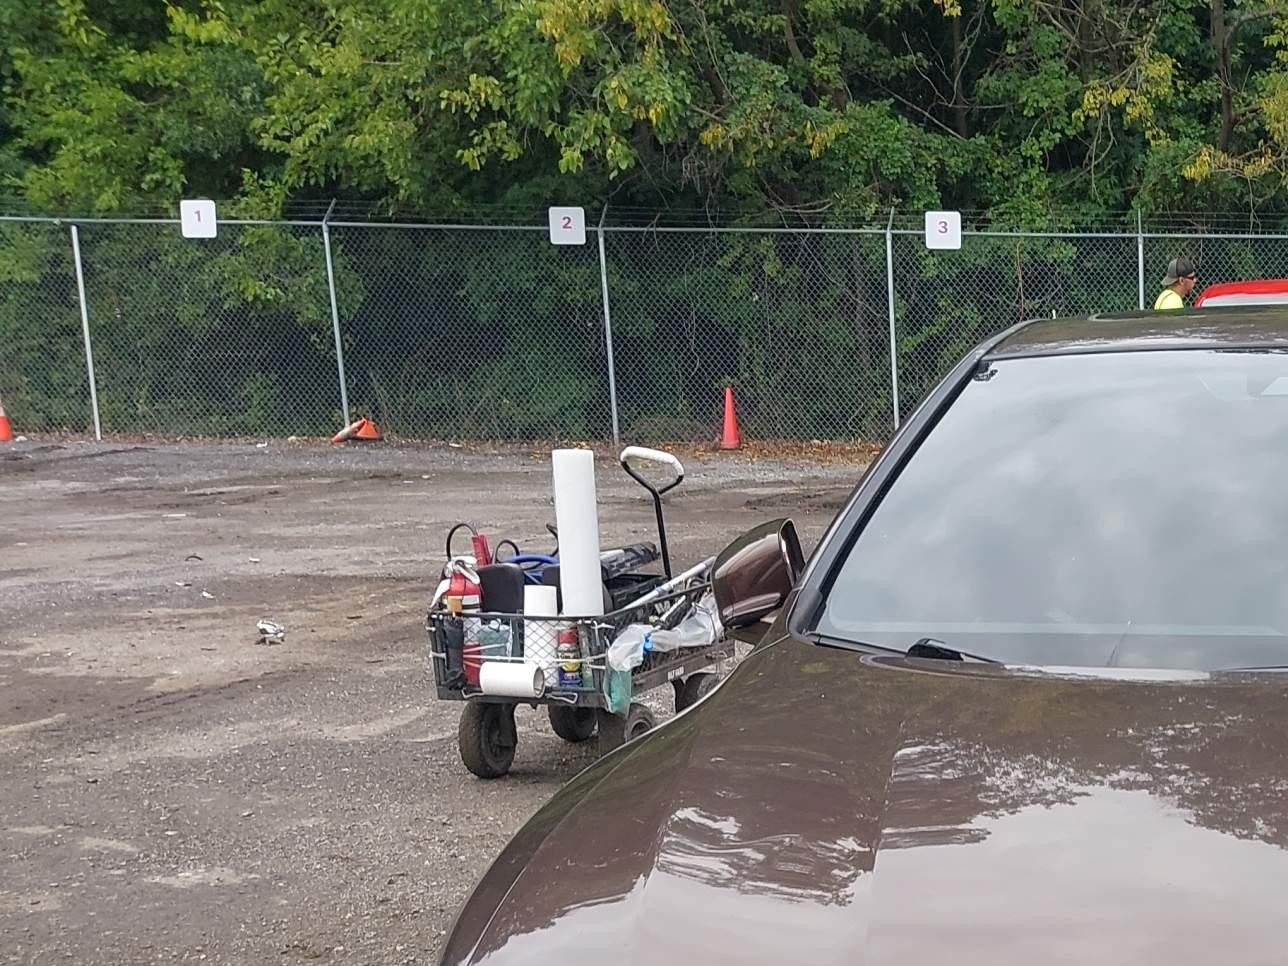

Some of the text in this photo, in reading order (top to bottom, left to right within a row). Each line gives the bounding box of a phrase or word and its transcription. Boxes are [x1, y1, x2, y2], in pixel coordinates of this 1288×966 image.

[193, 209, 203, 223] 1
[562, 216, 573, 230] 2
[937, 220, 949, 234] 3
